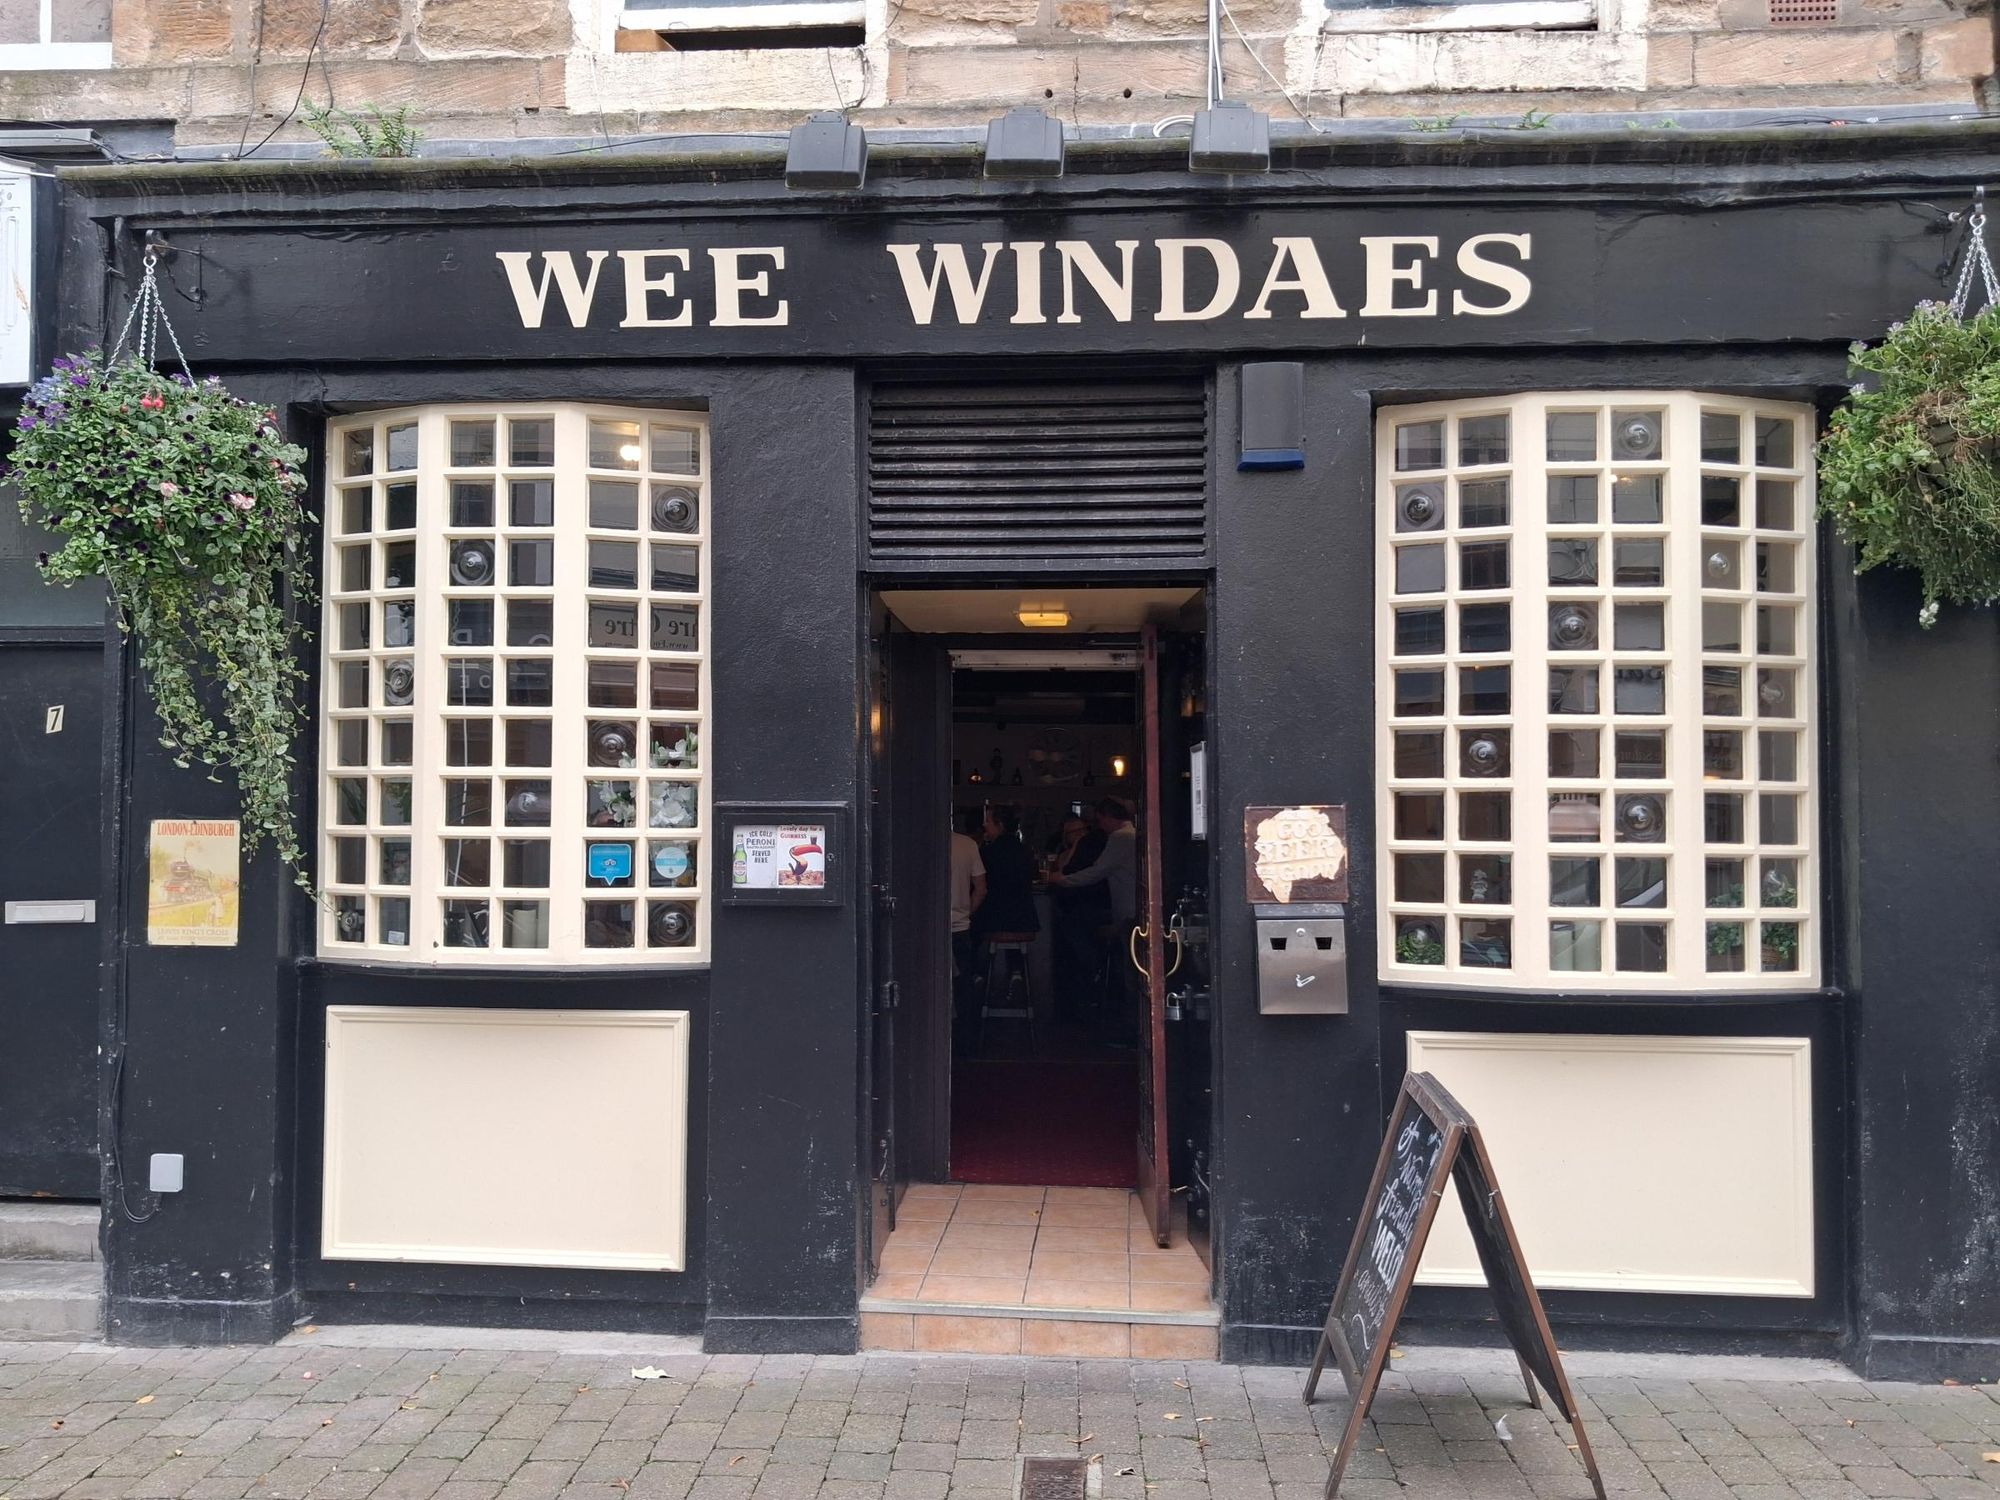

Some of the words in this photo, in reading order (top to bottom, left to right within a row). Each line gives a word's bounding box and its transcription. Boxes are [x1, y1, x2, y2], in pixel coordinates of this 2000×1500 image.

[496, 247, 789, 329] WEE
[886, 232, 1532, 325] WINDAES
[51, 708, 61, 731] 7
[157, 822, 235, 837] LONDON-EDINBURGH
[746, 837, 775, 846] PERONI
[1372, 1218, 1405, 1294] WELCO
